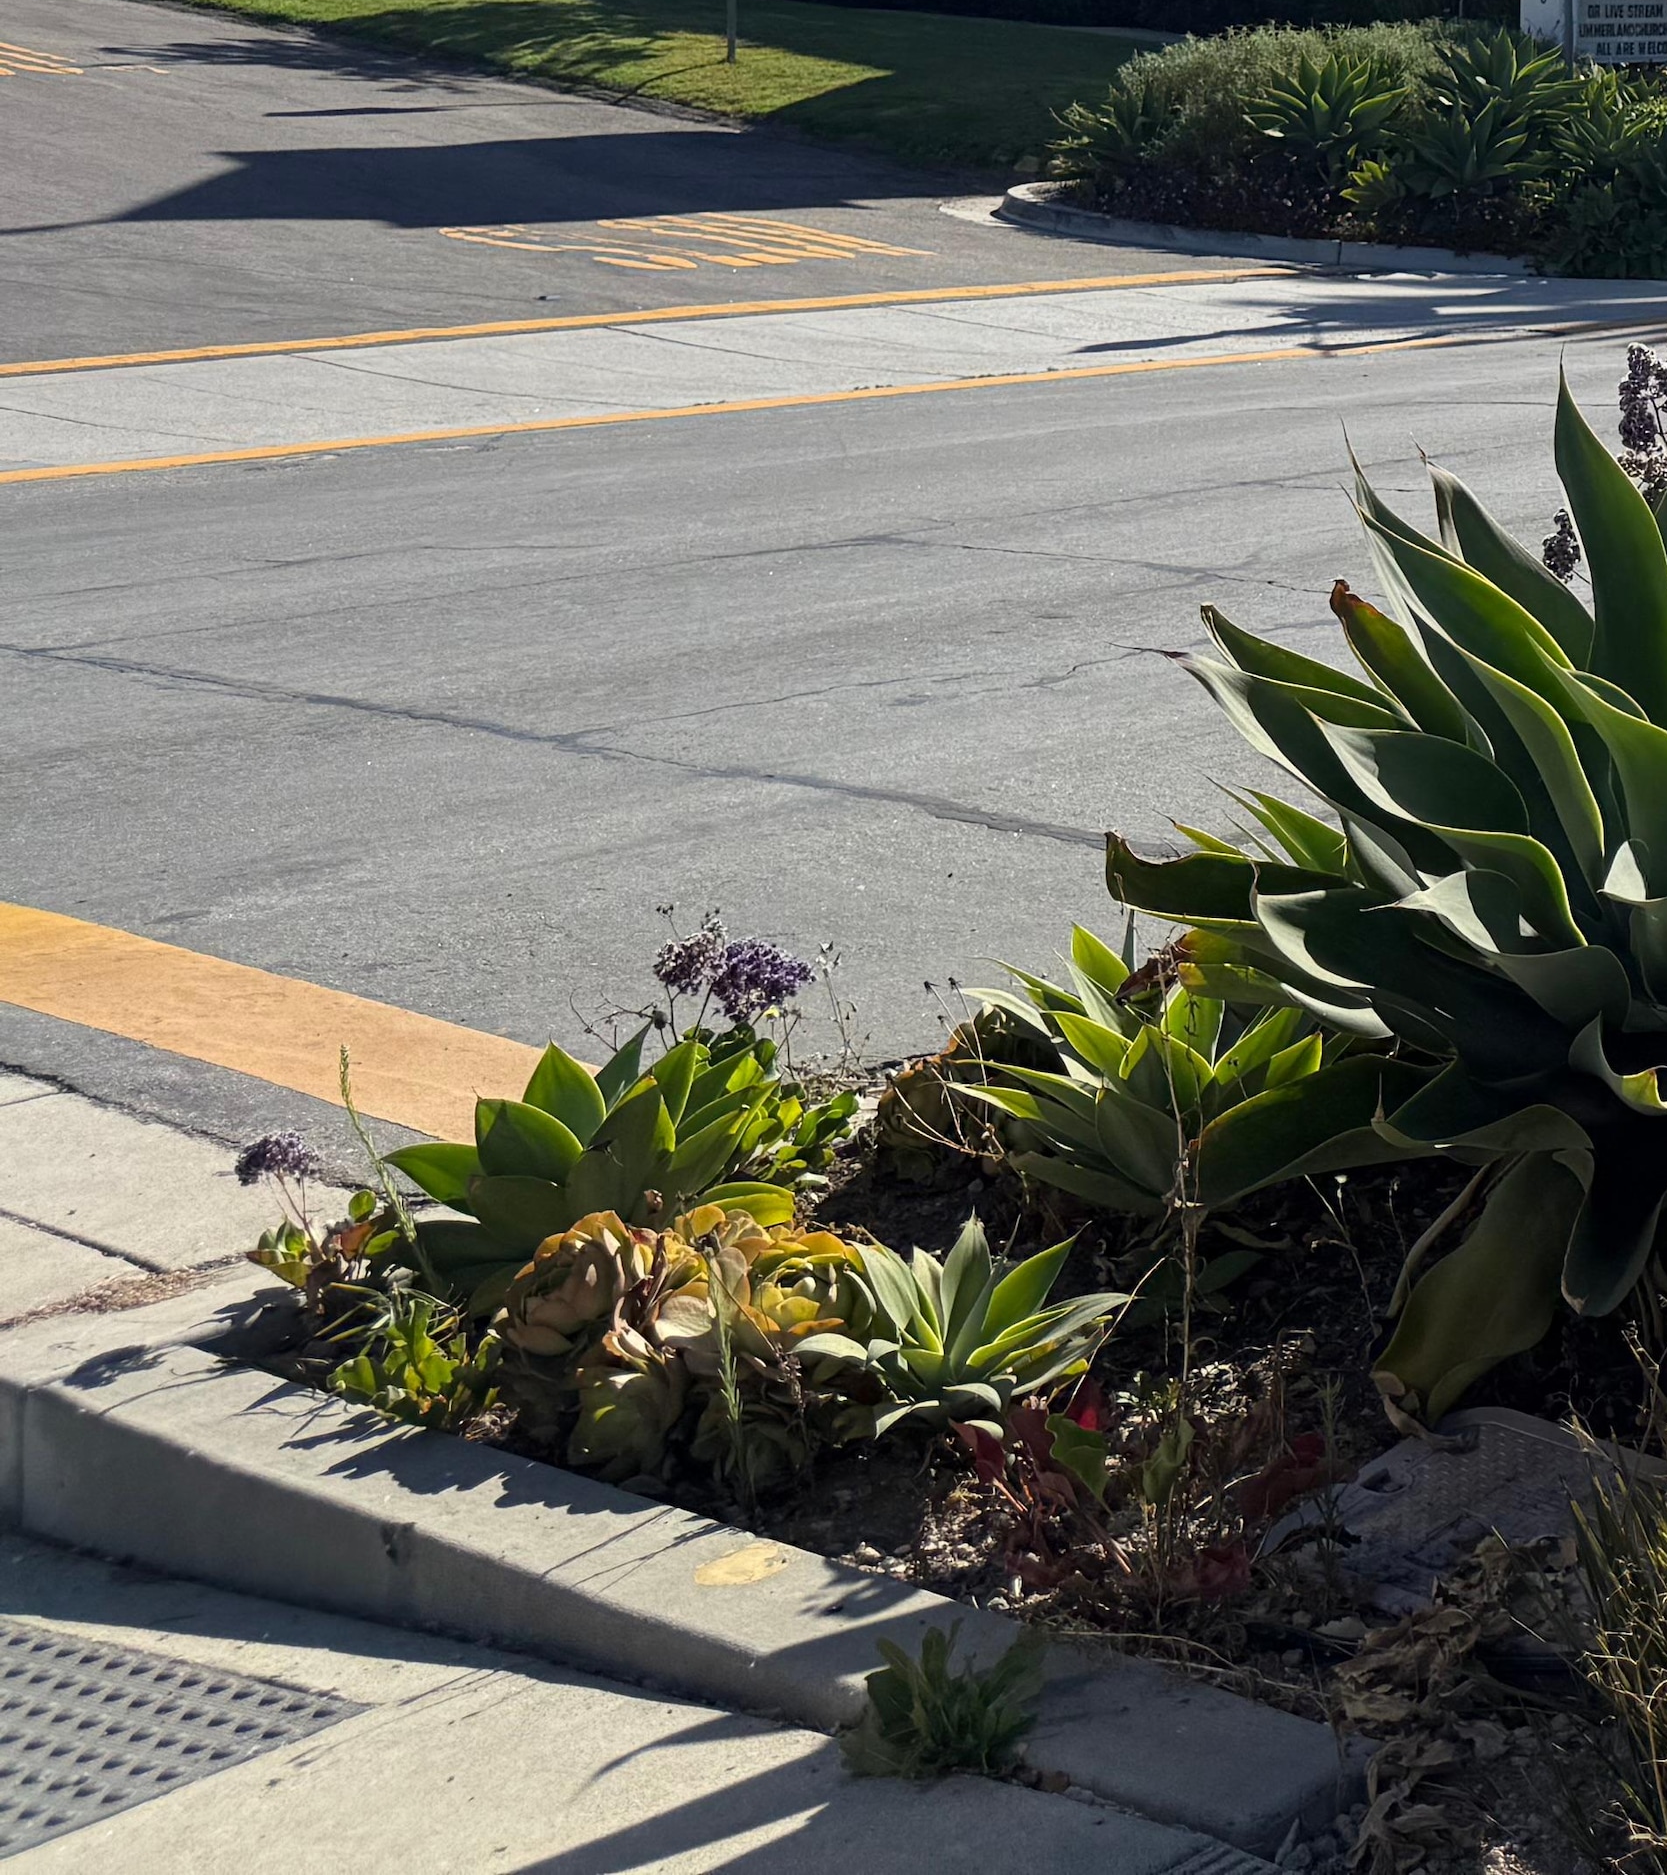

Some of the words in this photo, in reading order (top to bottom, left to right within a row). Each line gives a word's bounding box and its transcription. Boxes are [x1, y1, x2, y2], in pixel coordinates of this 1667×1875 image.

[1588, 5, 1600, 18] OR
[1605, 4, 1624, 18] LIVE
[1627, 4, 1663, 18] STREAM
[1596, 42, 1612, 56] ALL
[1616, 42, 1635, 56] ARE
[1638, 41, 1667, 55] WELCO
